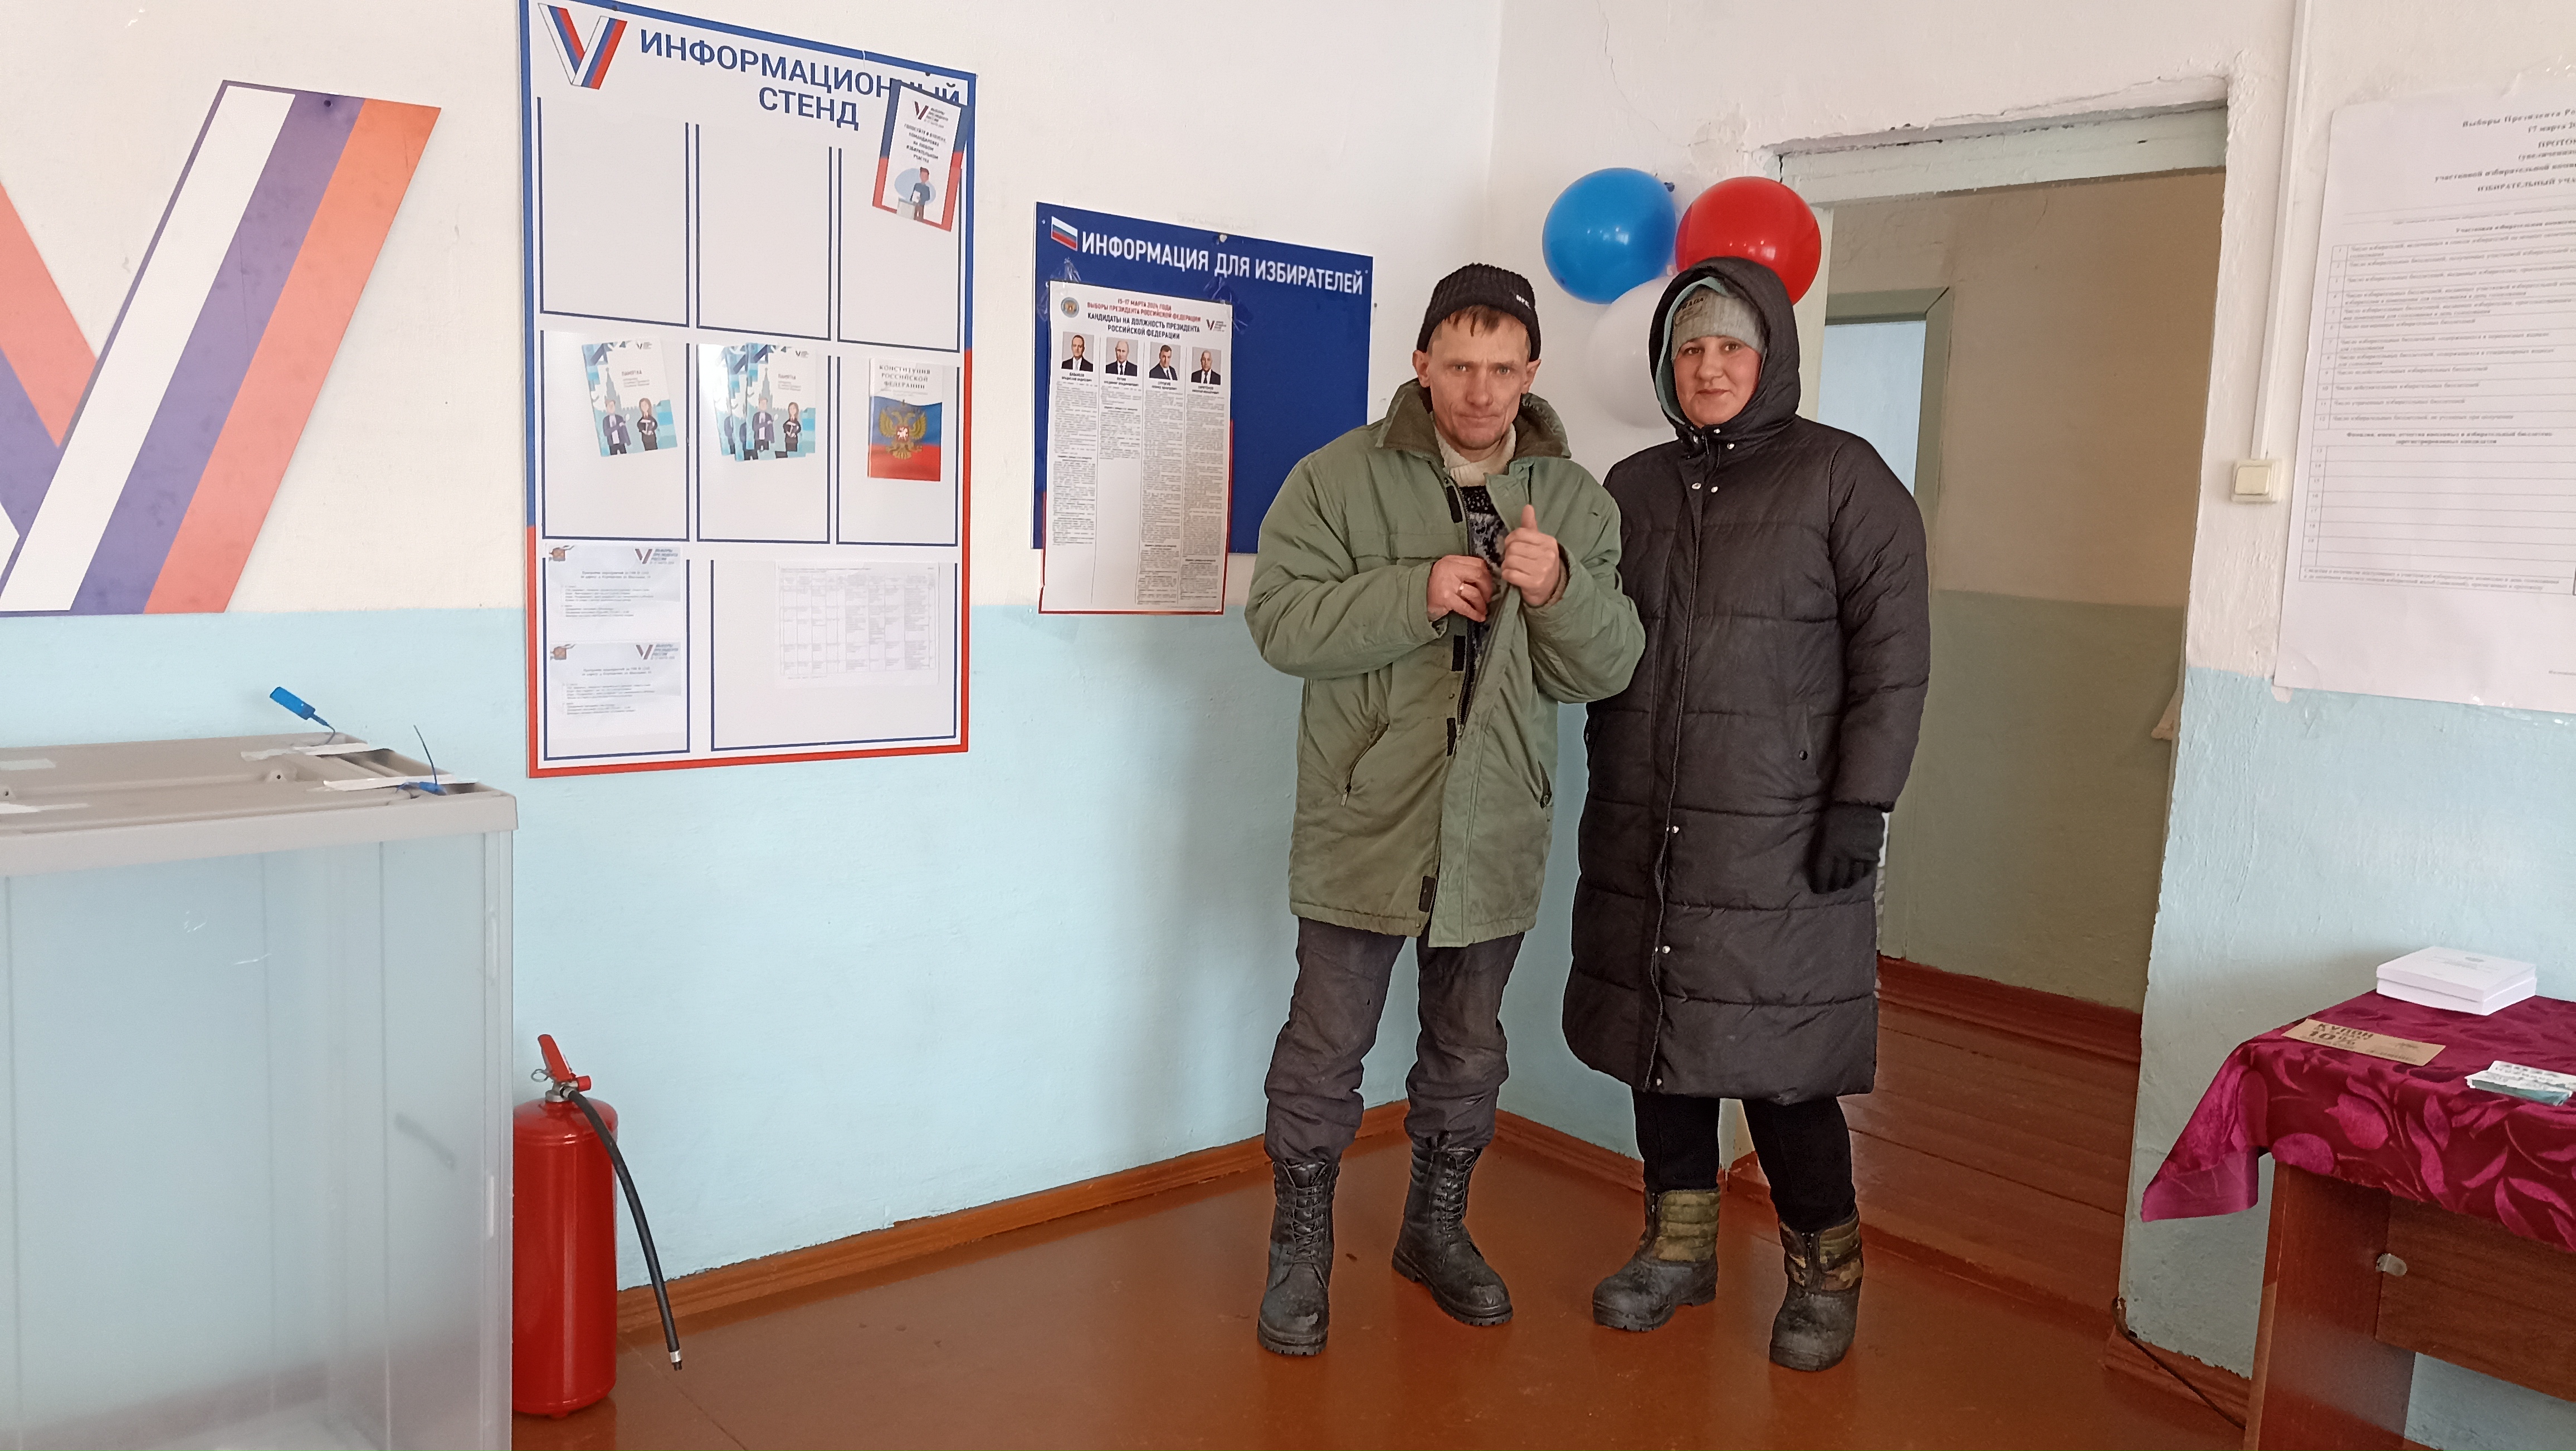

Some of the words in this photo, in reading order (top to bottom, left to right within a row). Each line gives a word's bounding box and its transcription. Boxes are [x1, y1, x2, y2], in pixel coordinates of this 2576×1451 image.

[759, 87, 859, 131] СТЕНД
[1082, 231, 1209, 272] ИНФОРМАЦИЯ
[1214, 252, 1250, 278] ДЛЯ
[1255, 259, 1363, 295] ИЗБИРАТЕЛЕЙ
[1087, 301, 1109, 310] ВЫБОРЫ
[1109, 305, 1140, 314] ПРЕЗИДЕНТА
[1087, 312, 1121, 323] КАНДИДАТЫ
[1131, 318, 1165, 329] ДОЛЖНОСТЬ
[1166, 322, 1200, 333] ПРЕЗИДЕНТА
[1108, 324, 1145, 335] РОССИЙСКОЙ
[1146, 329, 1180, 339] ФЕДЕРАЦИИ
